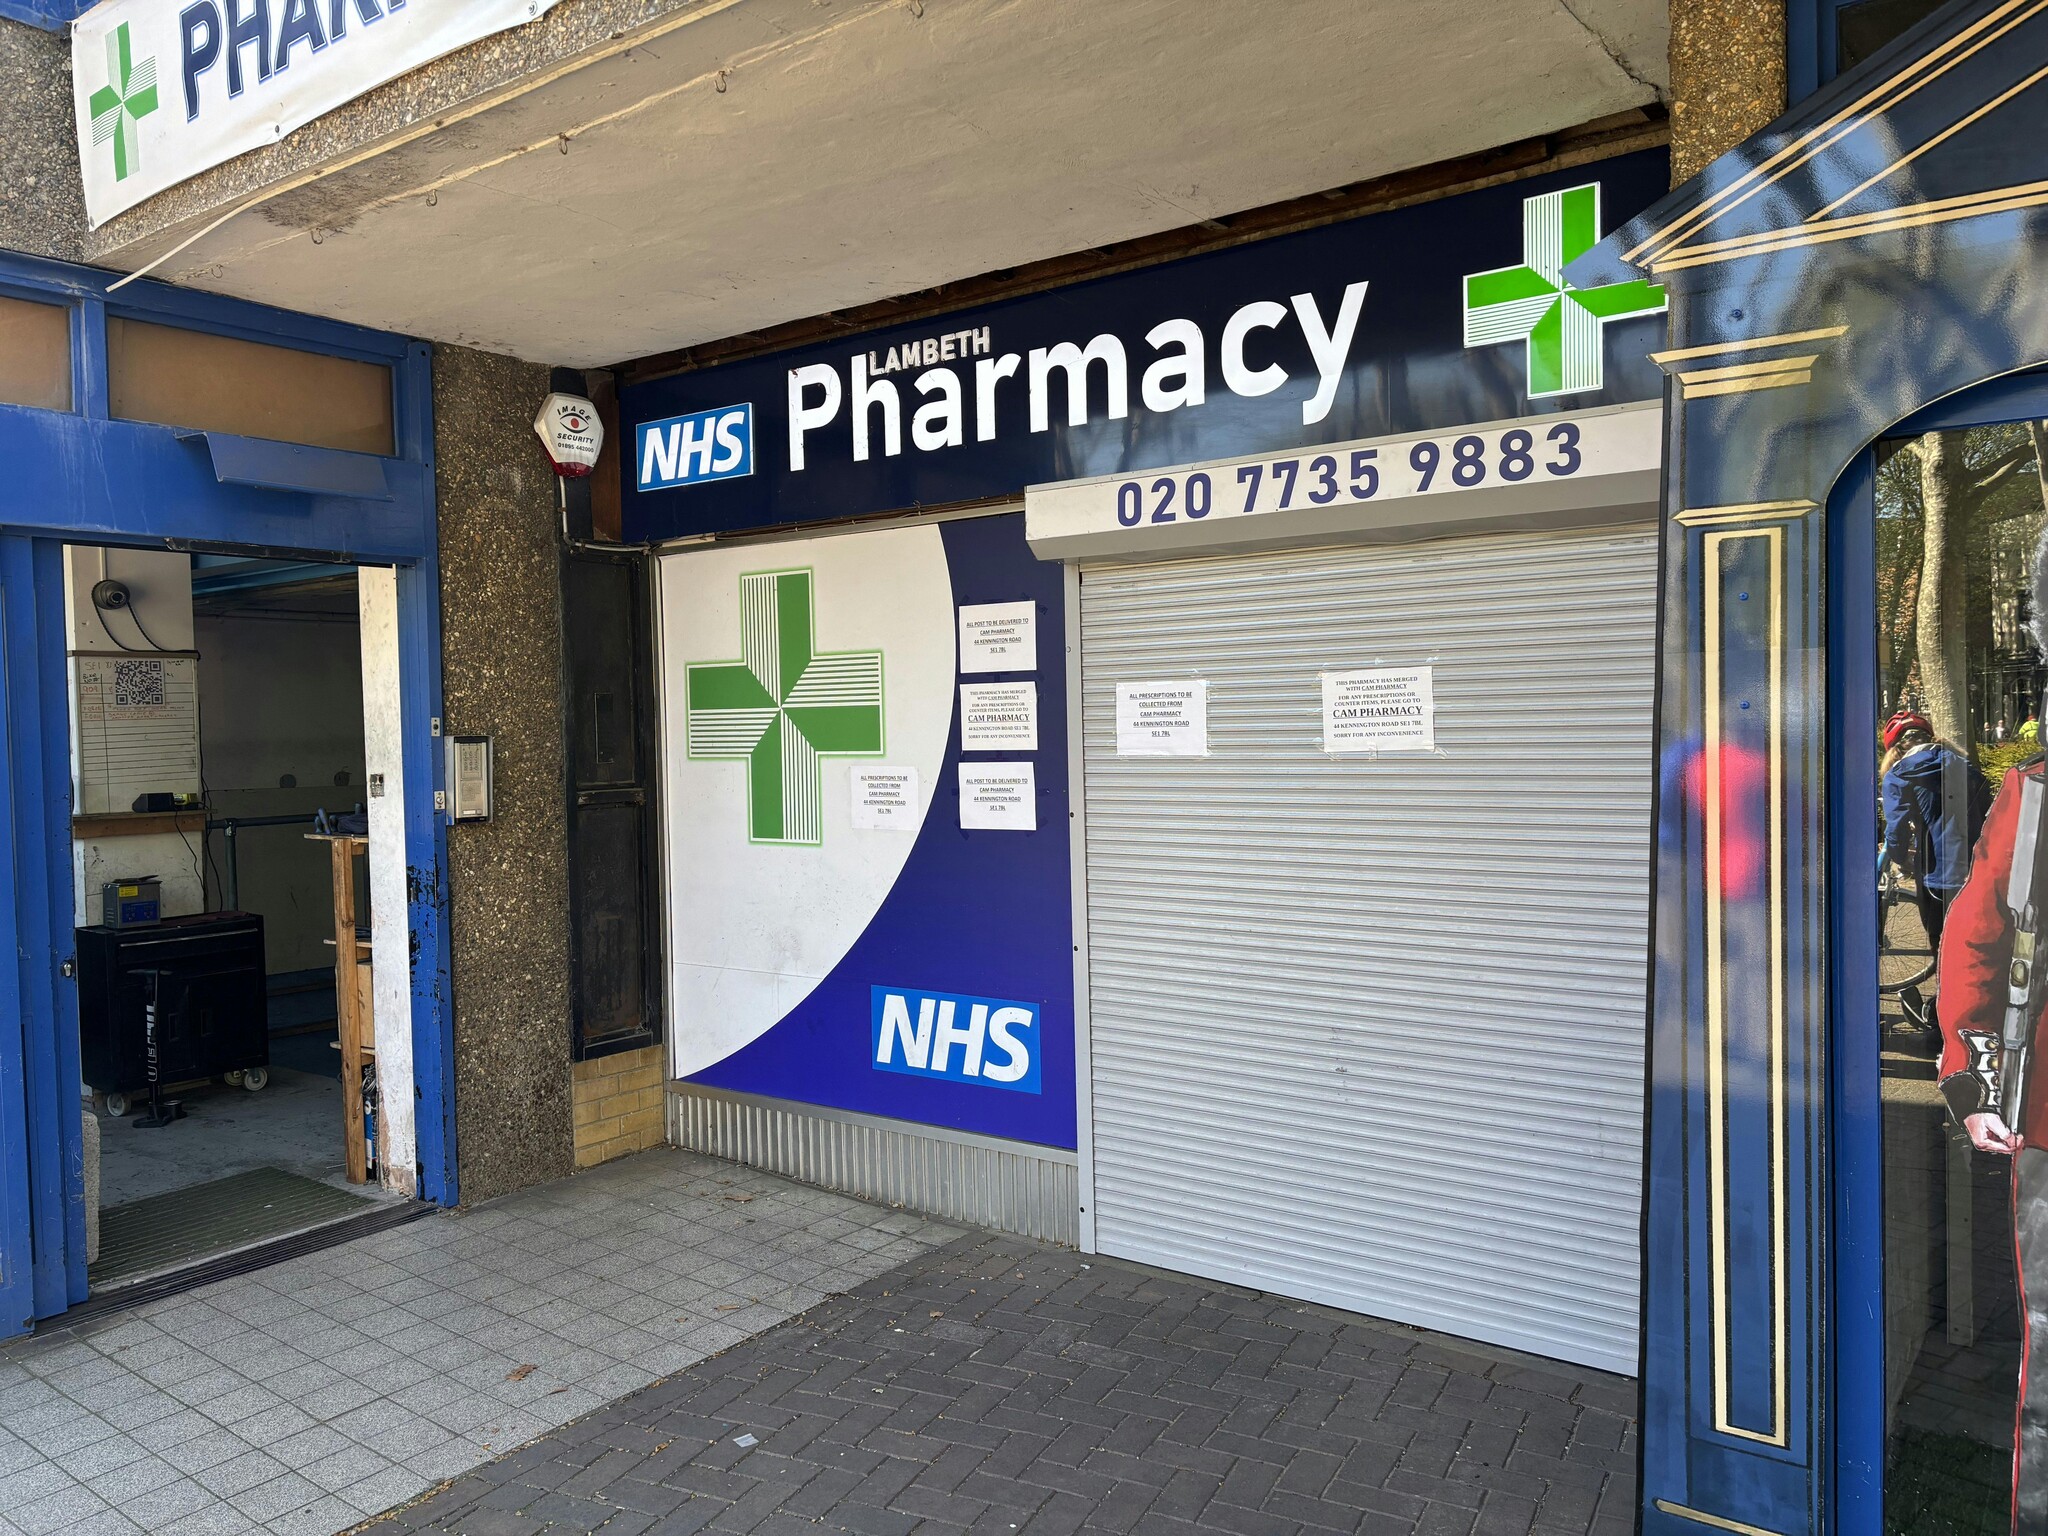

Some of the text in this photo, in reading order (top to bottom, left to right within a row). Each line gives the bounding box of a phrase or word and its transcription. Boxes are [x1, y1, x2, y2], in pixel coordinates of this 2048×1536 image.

[788, 281, 1369, 472] Pharmacy
[869, 326, 990, 376] LAMBETH
[557, 405, 592, 421] IMAGE
[557, 433, 594, 444] SECURITY
[641, 411, 745, 484] NHS
[1117, 422, 1582, 527] 020 7735 9883
[1333, 706, 1422, 717] CAM PHARMACY
[877, 994, 1033, 1082] NHS
